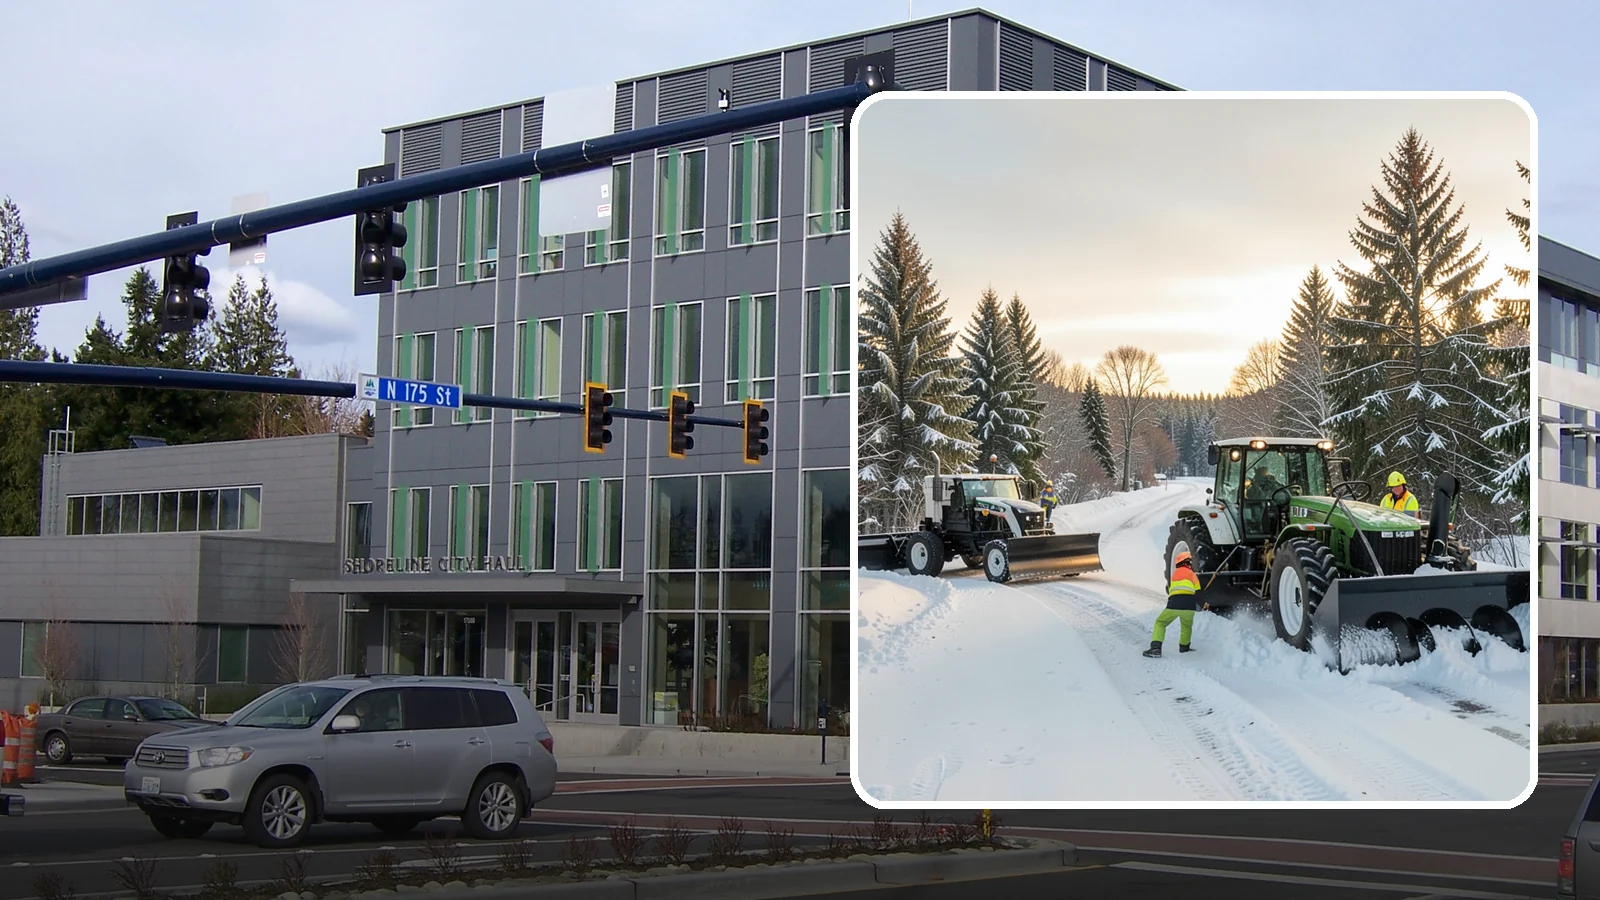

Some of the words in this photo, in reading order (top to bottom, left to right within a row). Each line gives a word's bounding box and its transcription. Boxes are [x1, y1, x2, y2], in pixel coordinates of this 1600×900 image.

[387, 380, 396, 400] N
[405, 382, 428, 403] 175
[436, 386, 451, 406] St
[343, 556, 432, 574] SHORELINE
[438, 555, 477, 573] CITY
[483, 555, 526, 572] HALL
